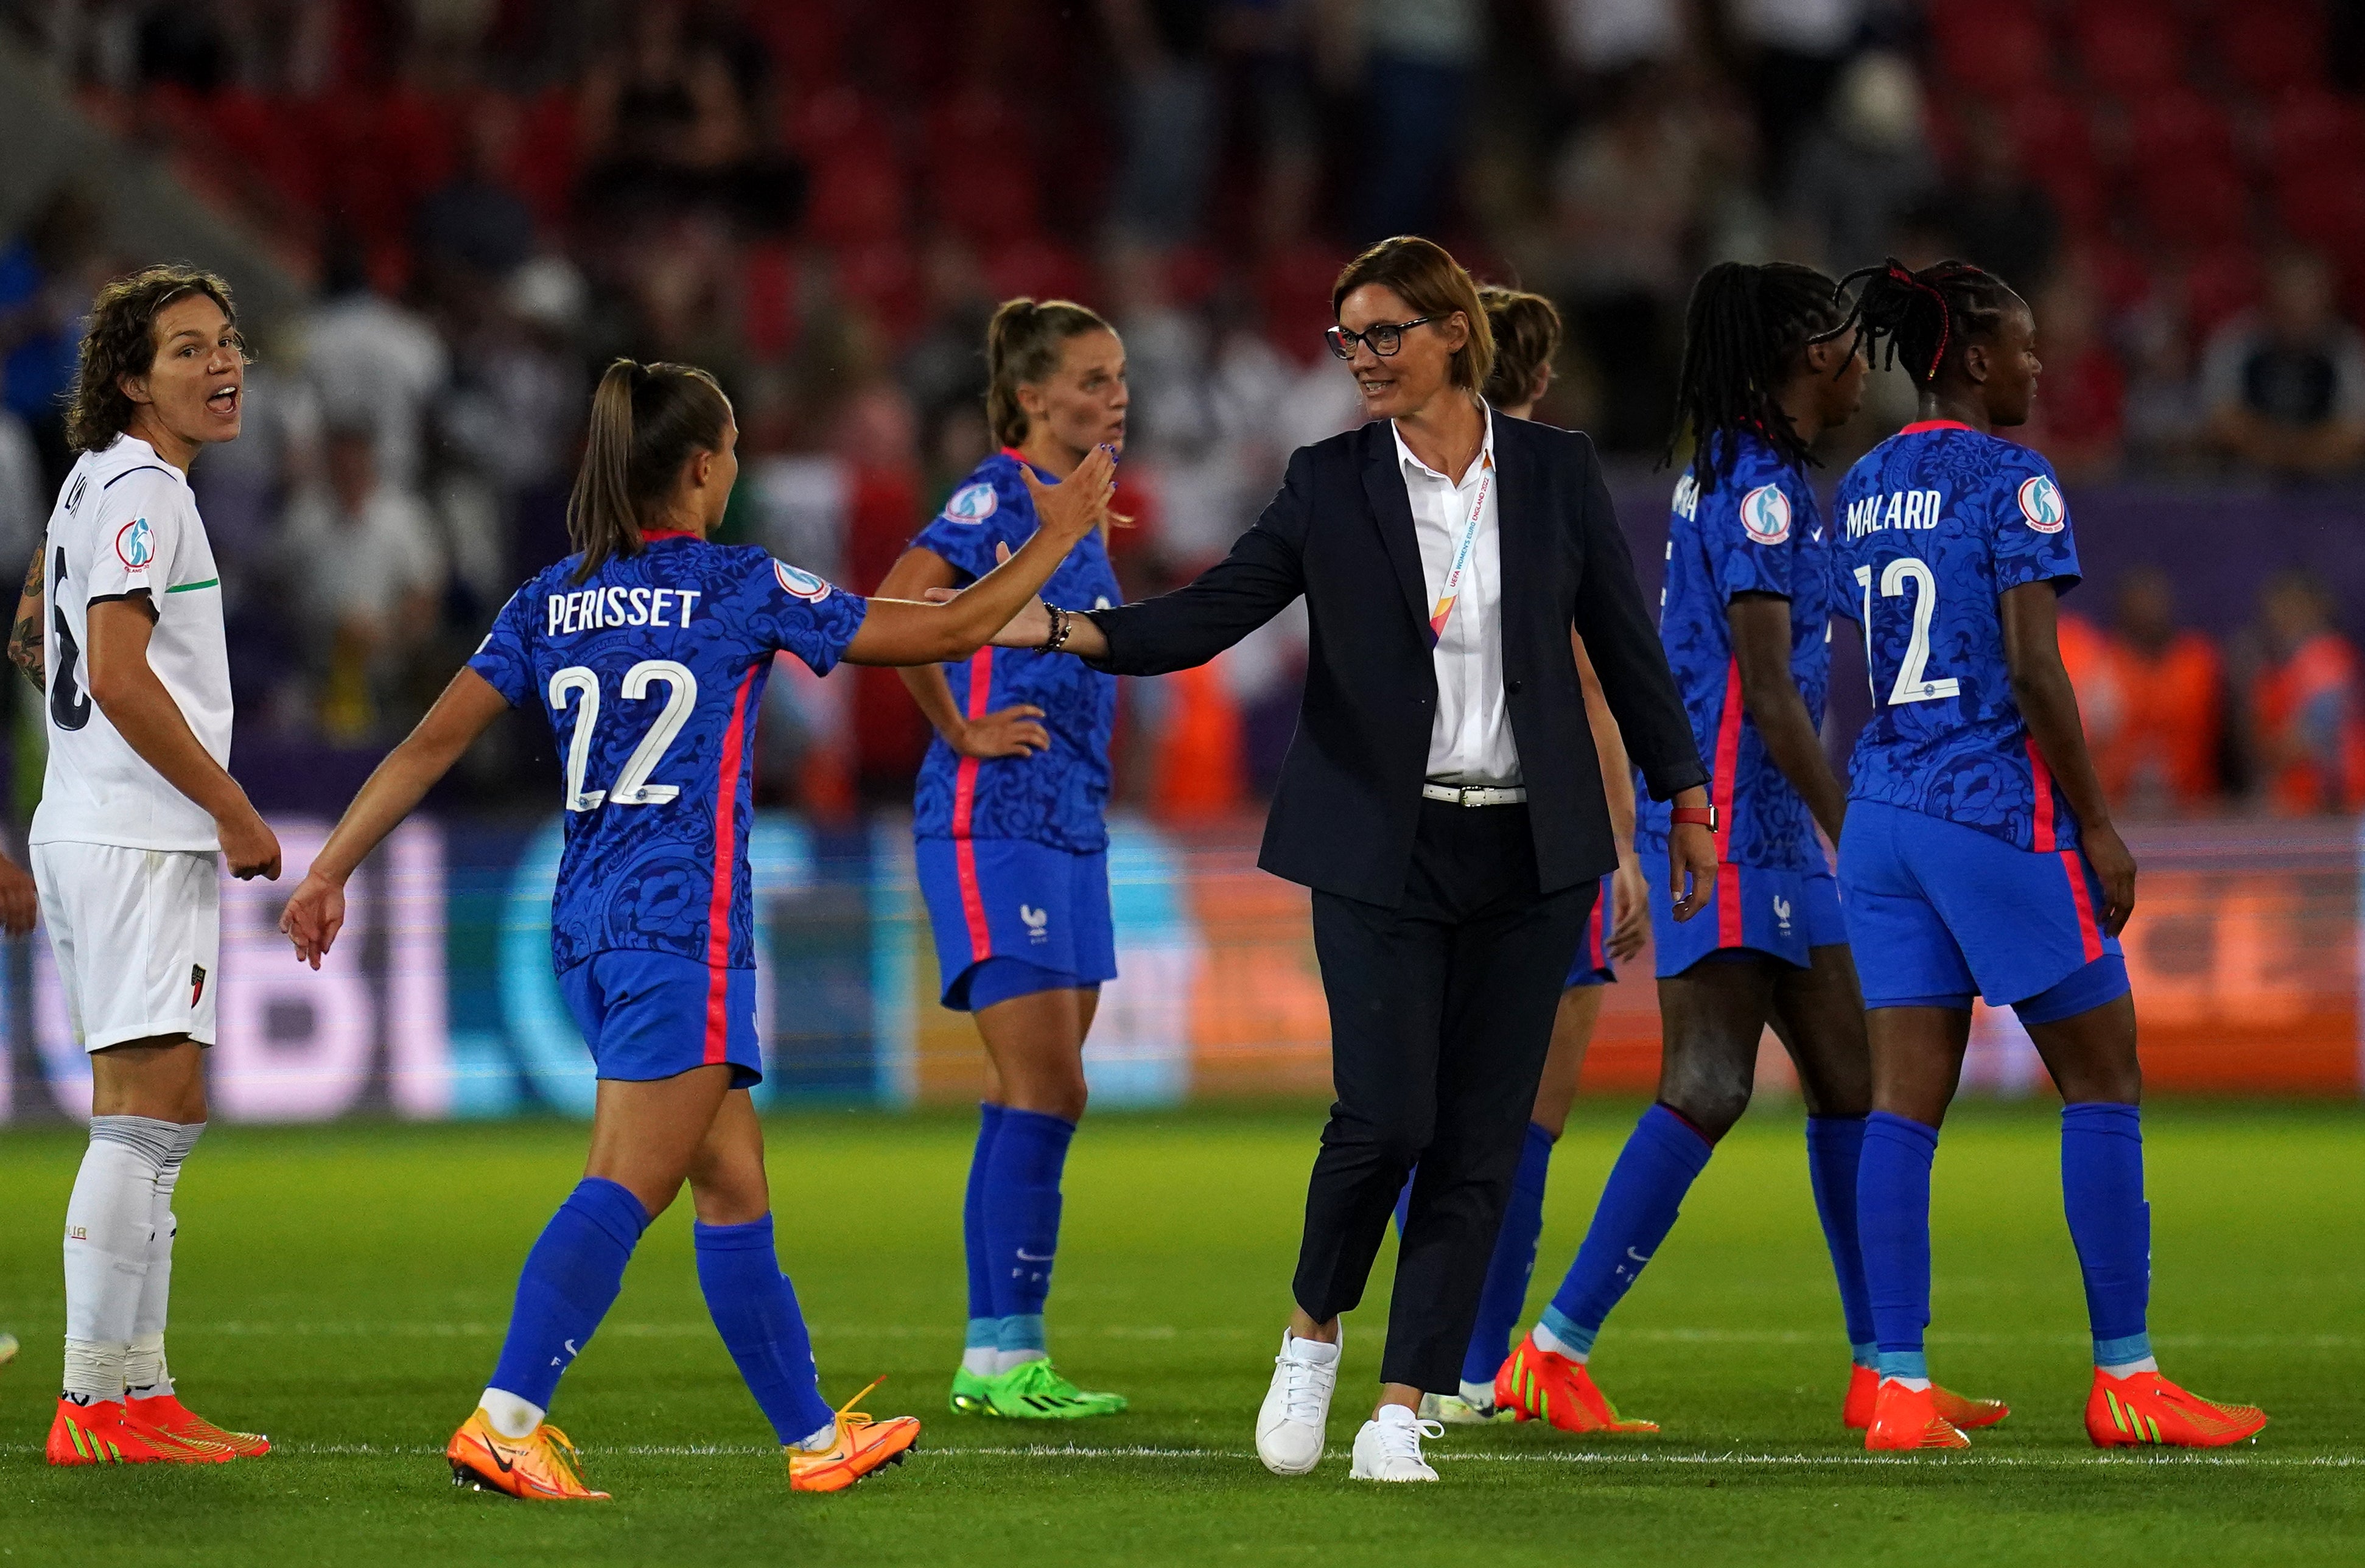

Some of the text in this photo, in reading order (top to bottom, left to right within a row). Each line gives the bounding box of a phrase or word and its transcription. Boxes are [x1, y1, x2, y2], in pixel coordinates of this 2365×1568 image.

[1449, 477, 1490, 587] UEFA WOMEN'S EURO ENGLAND 2022
[1846, 490, 1941, 542] MALARD
[548, 586, 701, 637] PERISSET
[1853, 558, 1960, 709] 12
[548, 659, 698, 813] 22
